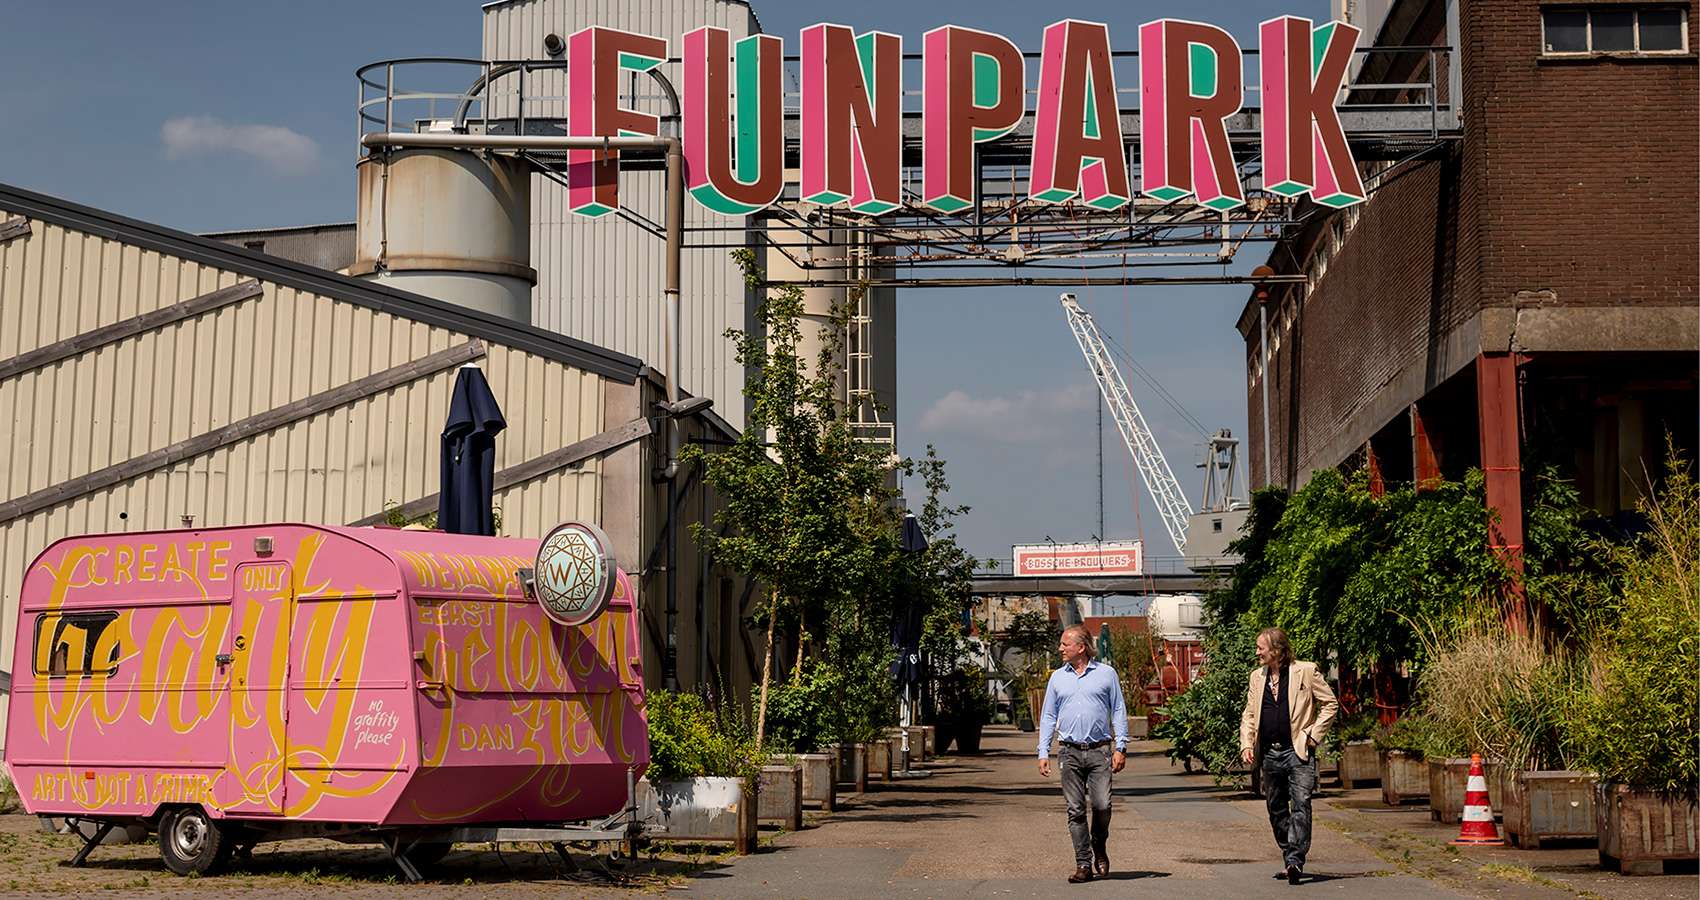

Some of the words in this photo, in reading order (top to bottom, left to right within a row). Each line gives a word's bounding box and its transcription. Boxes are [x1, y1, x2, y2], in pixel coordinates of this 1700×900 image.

[567, 15, 1366, 218] FUNPARK
[88, 540, 231, 585] CREATE
[549, 562, 573, 586] W
[243, 565, 286, 592] ONLY
[418, 602, 494, 627] EERST
[354, 727, 392, 750] please
[458, 724, 514, 751] DAN
[32, 774, 67, 801] ART
[71, 775, 89, 803] IS
[95, 773, 131, 804] NOT
[135, 773, 147, 805] A
